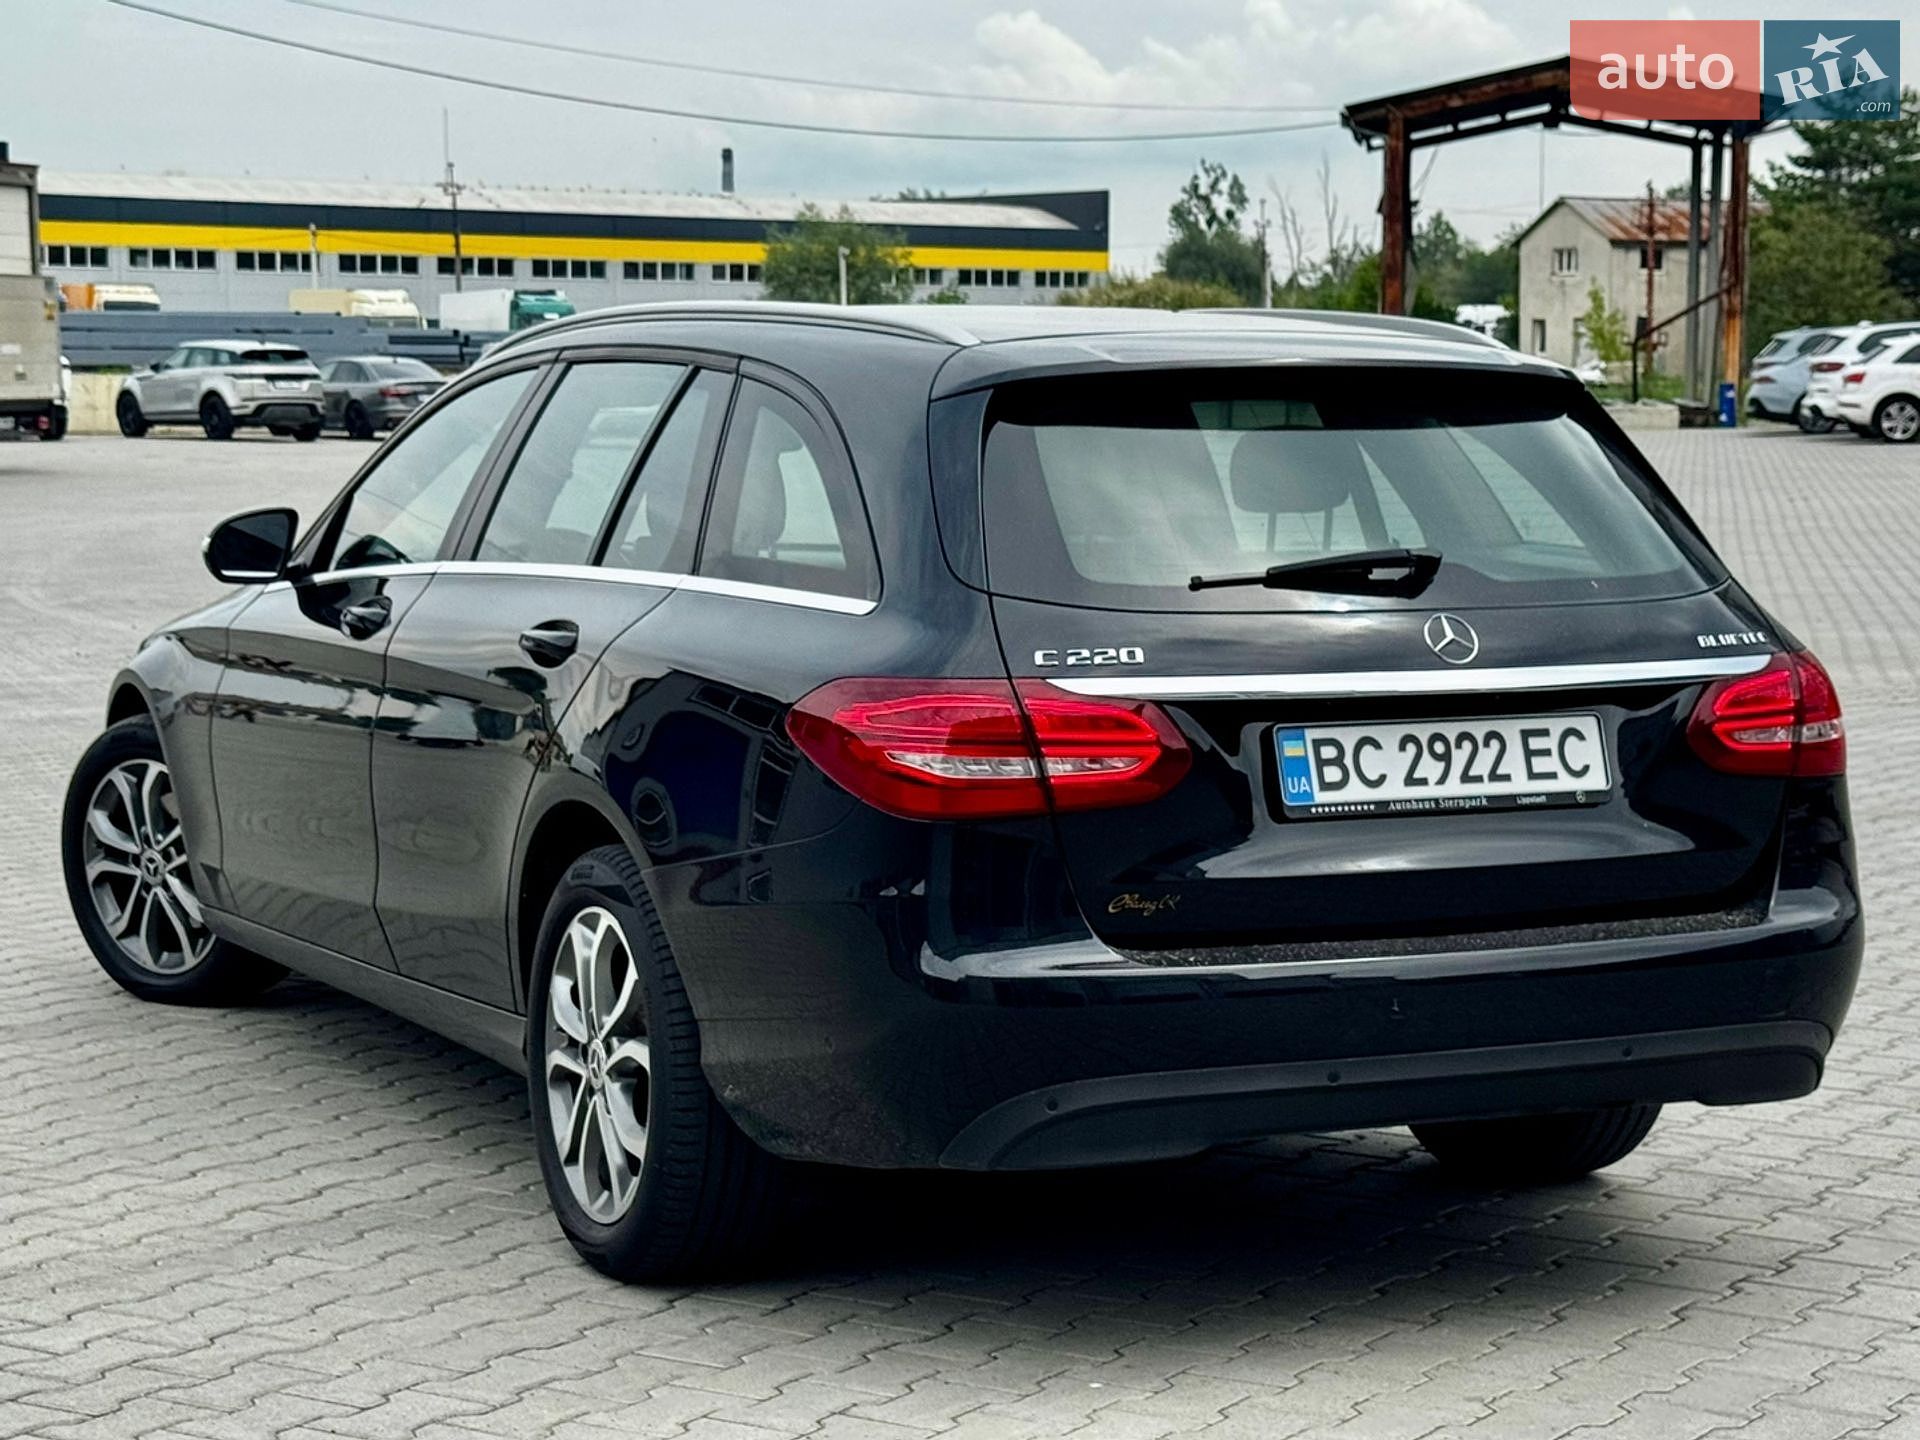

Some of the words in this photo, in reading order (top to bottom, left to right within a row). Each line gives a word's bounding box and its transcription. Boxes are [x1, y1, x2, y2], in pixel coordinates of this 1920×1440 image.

[1034, 649, 1059, 666] C
[1066, 647, 1144, 665] 220
[1311, 735, 1387, 792] BC
[1398, 730, 1512, 787] 2922
[1520, 727, 1591, 782] EC
[1287, 776, 1311, 794] UA
[1388, 799, 1436, 812] Autohaus
[1439, 795, 1488, 809] Sternpark
